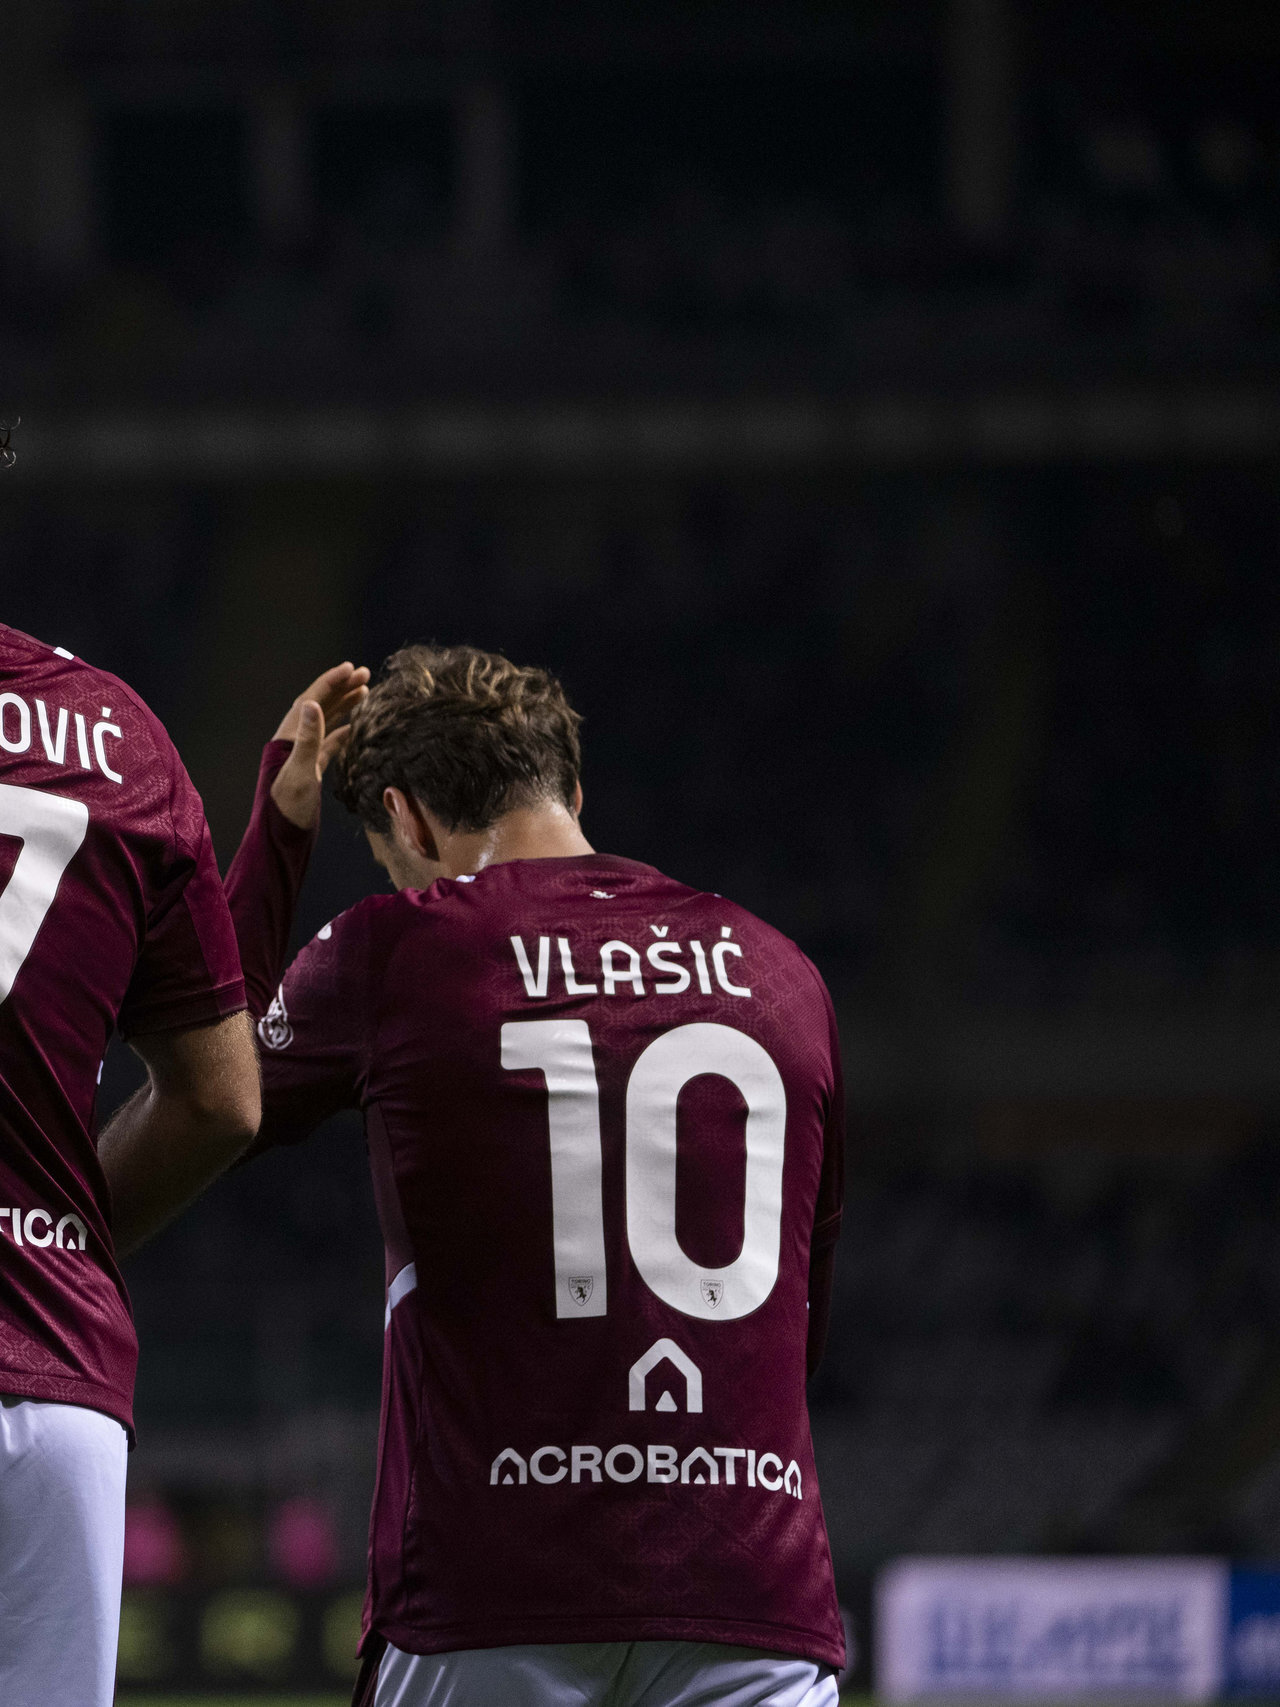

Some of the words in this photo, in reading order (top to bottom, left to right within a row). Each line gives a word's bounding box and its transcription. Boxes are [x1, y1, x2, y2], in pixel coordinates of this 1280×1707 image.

[509, 924, 753, 998] VLAŠIĆ
[500, 1018, 787, 1321] 10
[489, 1444, 804, 1501] ACROBATICA
